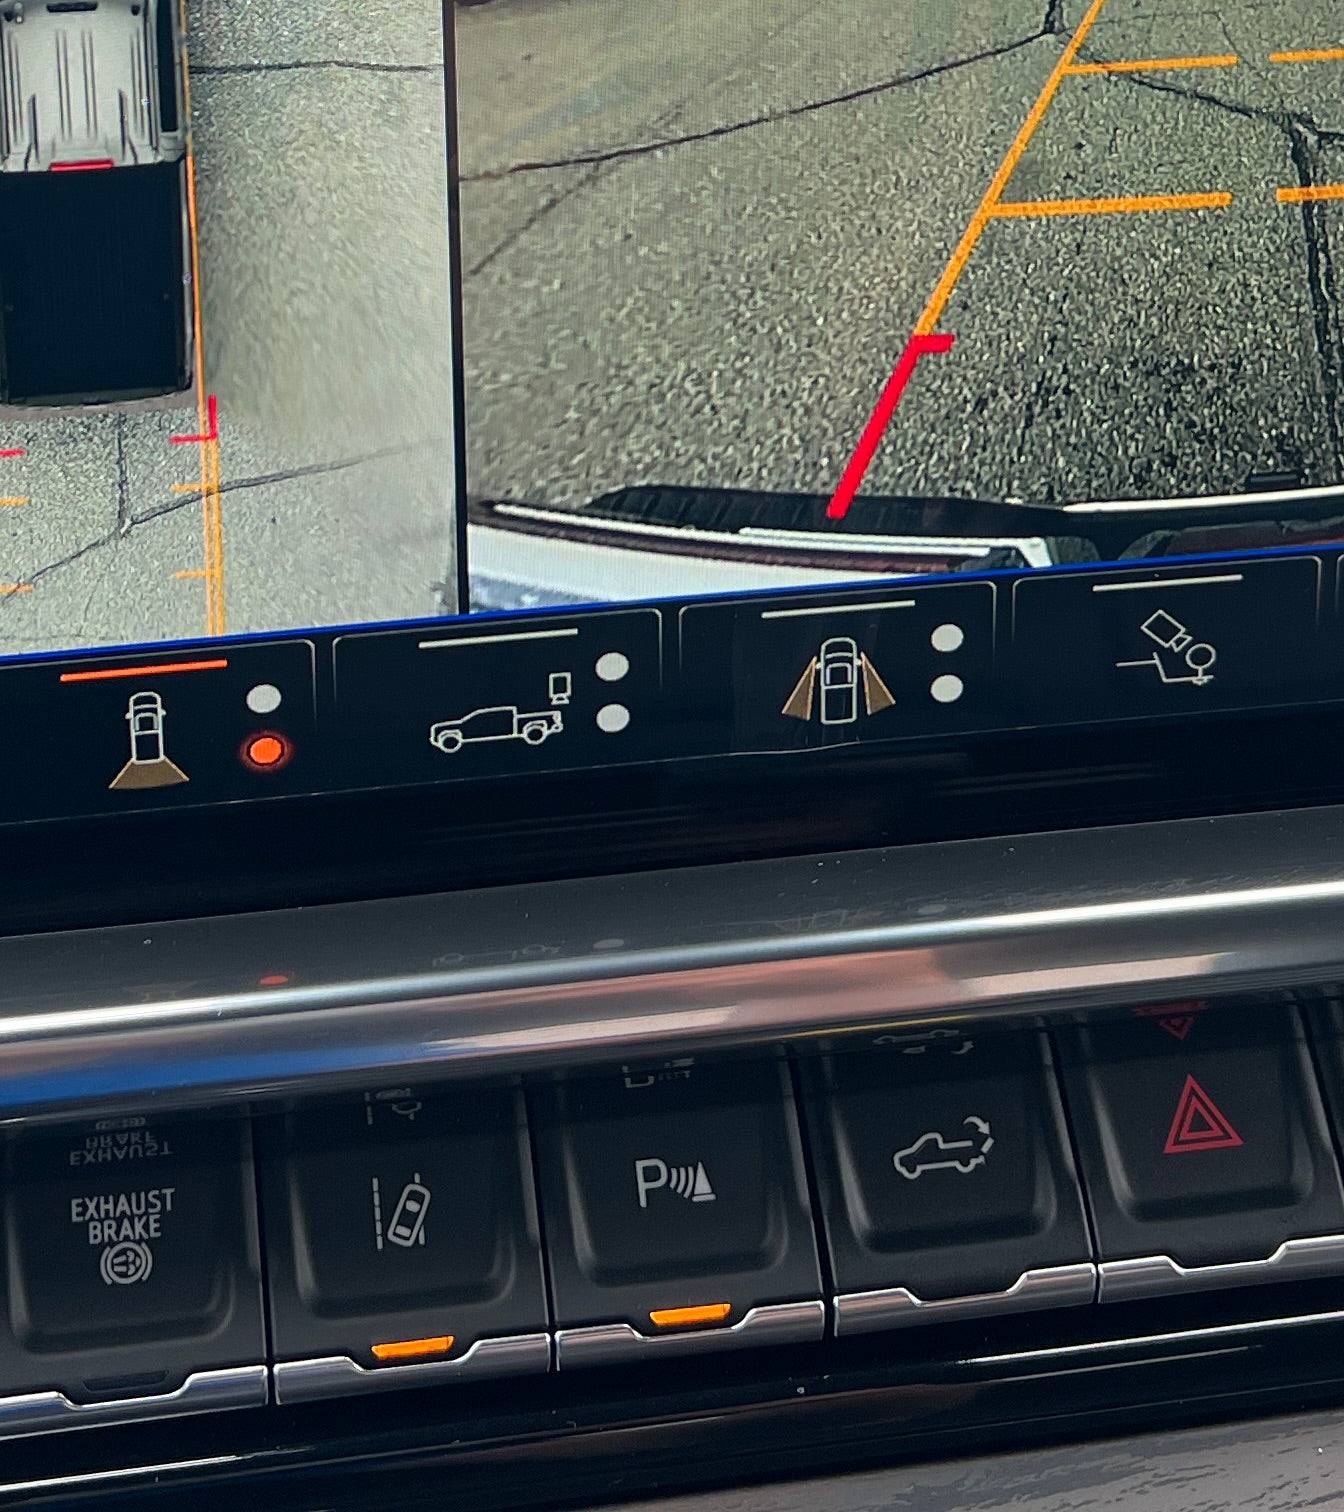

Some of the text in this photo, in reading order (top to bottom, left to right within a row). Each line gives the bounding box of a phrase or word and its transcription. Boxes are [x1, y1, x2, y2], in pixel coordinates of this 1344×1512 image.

[635, 1158, 668, 1208] P
[71, 1188, 175, 1222] EXHAUST
[89, 1214, 161, 1245] BRAKE
